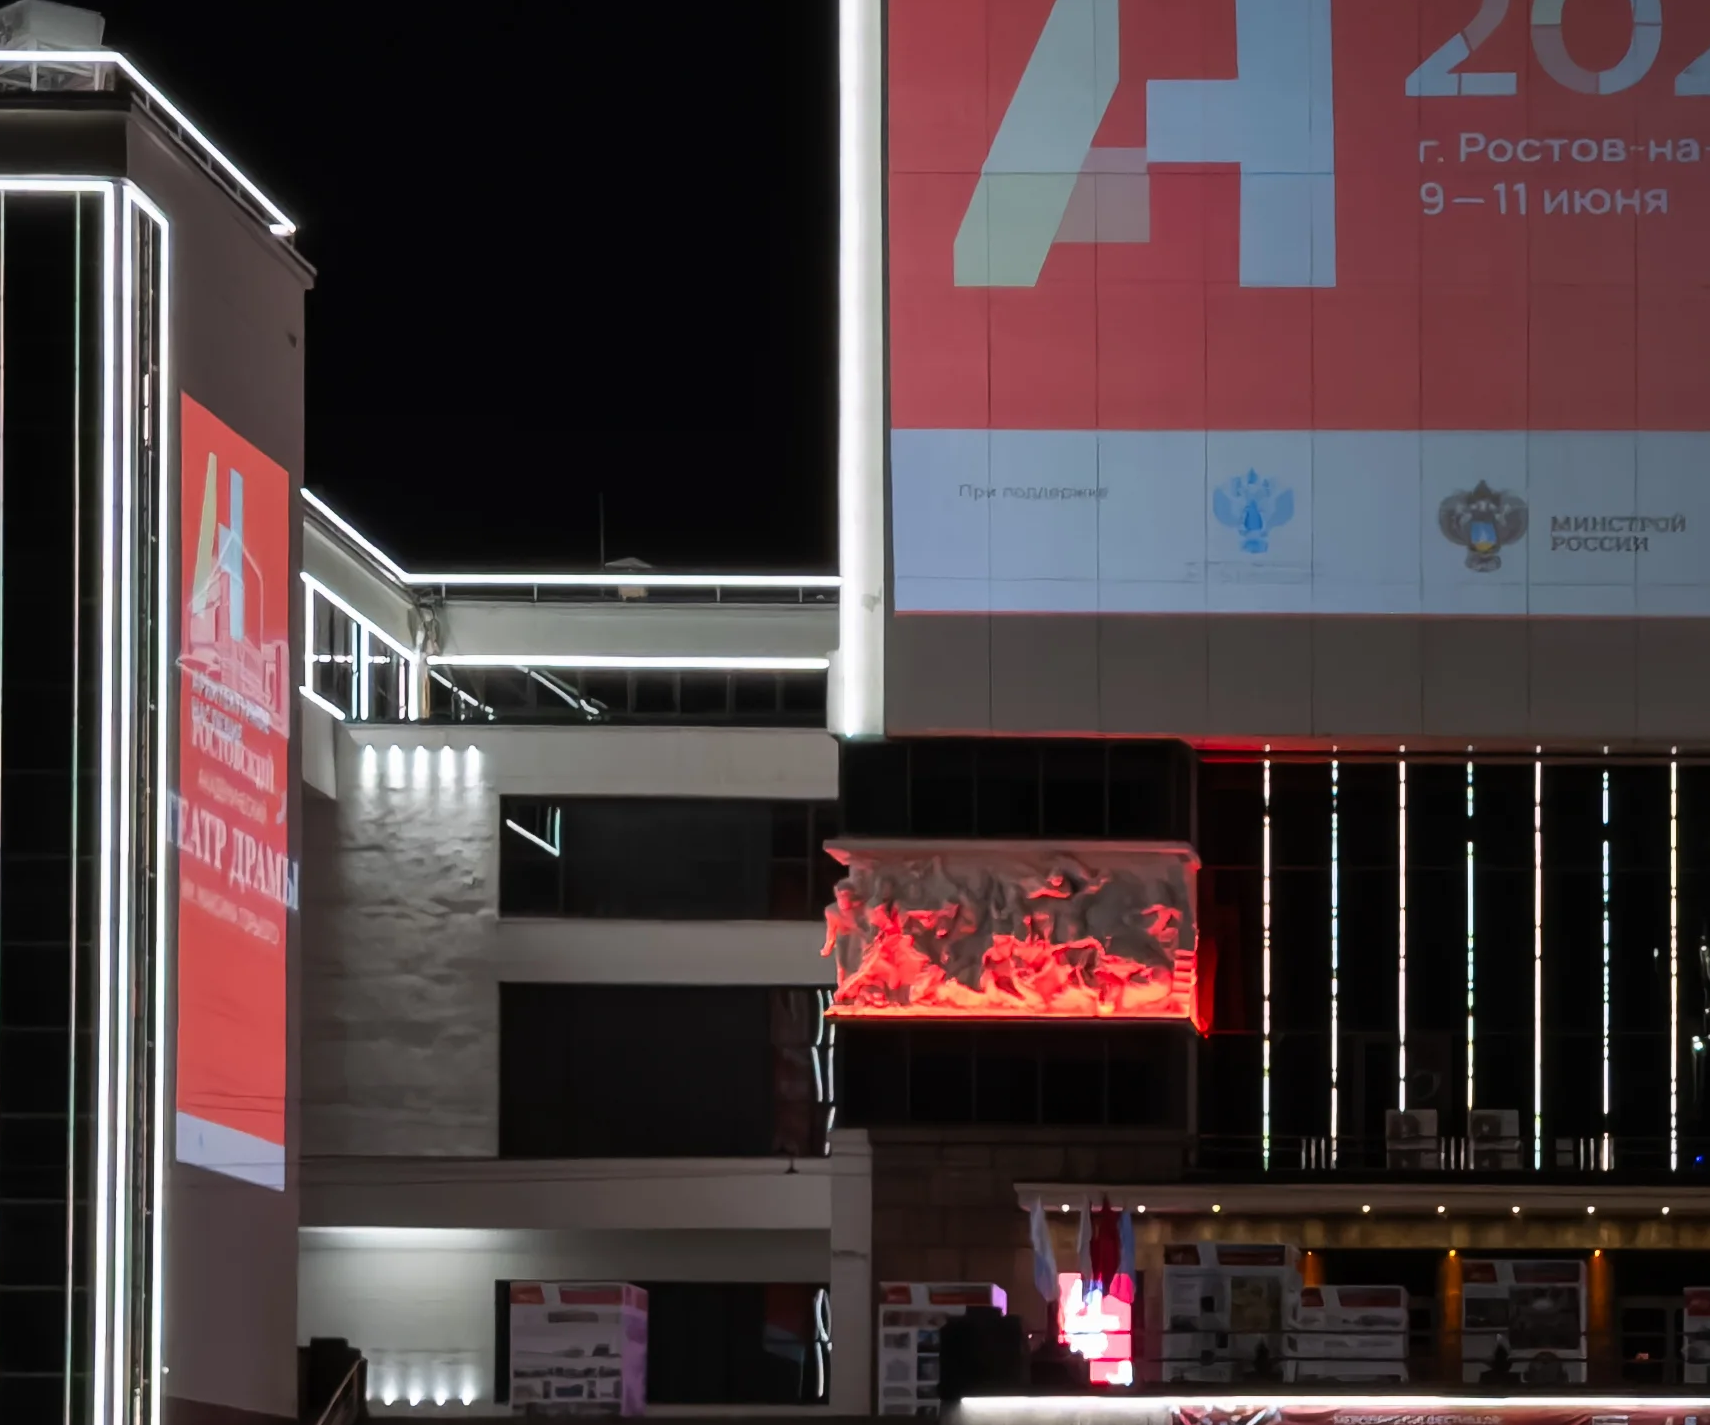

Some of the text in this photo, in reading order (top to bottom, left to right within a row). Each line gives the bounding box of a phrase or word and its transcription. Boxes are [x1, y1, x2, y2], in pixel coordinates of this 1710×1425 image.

[1418, 138, 1445, 164] г.
[1542, 187, 1670, 216] июня
[1550, 510, 1687, 533] МИНСТРОЙ
[1550, 534, 1650, 553] РОССИИ
[166, 787, 228, 871] ТЕАТР
[229, 827, 300, 911] ДРАМЫ
